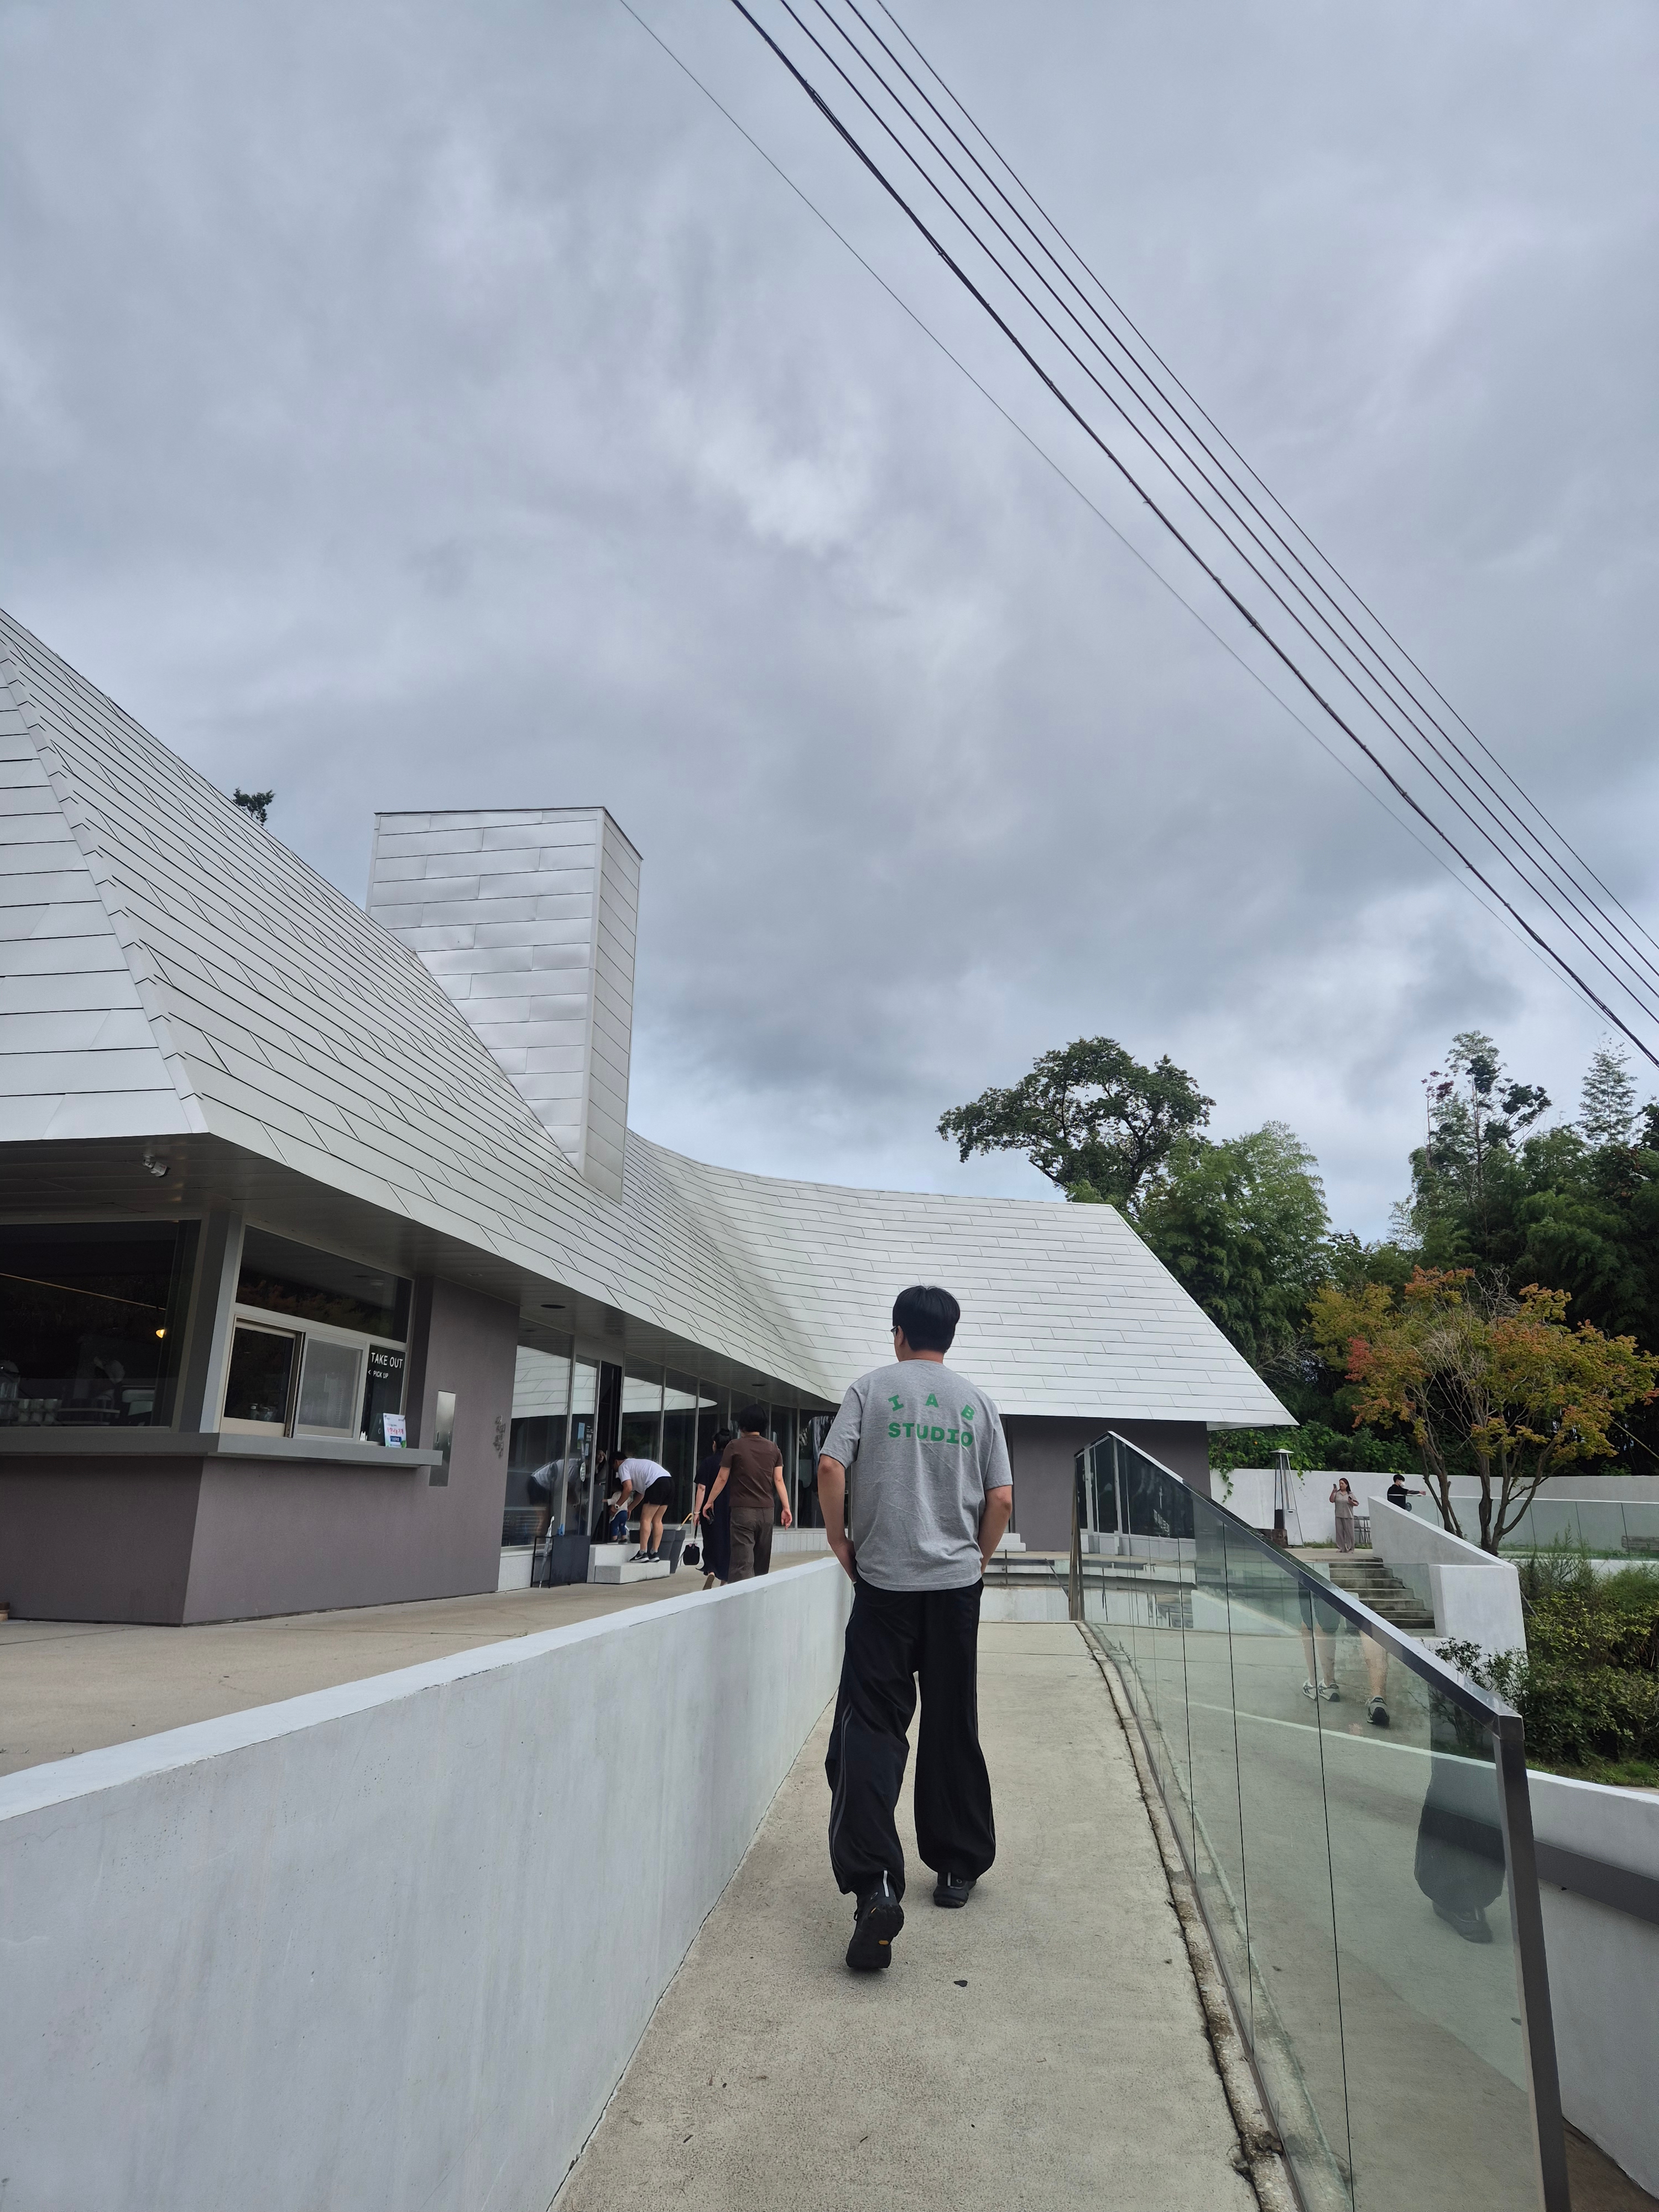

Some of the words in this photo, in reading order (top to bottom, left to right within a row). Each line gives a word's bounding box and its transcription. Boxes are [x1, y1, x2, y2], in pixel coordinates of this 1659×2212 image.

[371, 1352, 388, 1366] TAKE
[389, 1357, 403, 1369] OUT
[888, 1422, 973, 1447] STUDIO
